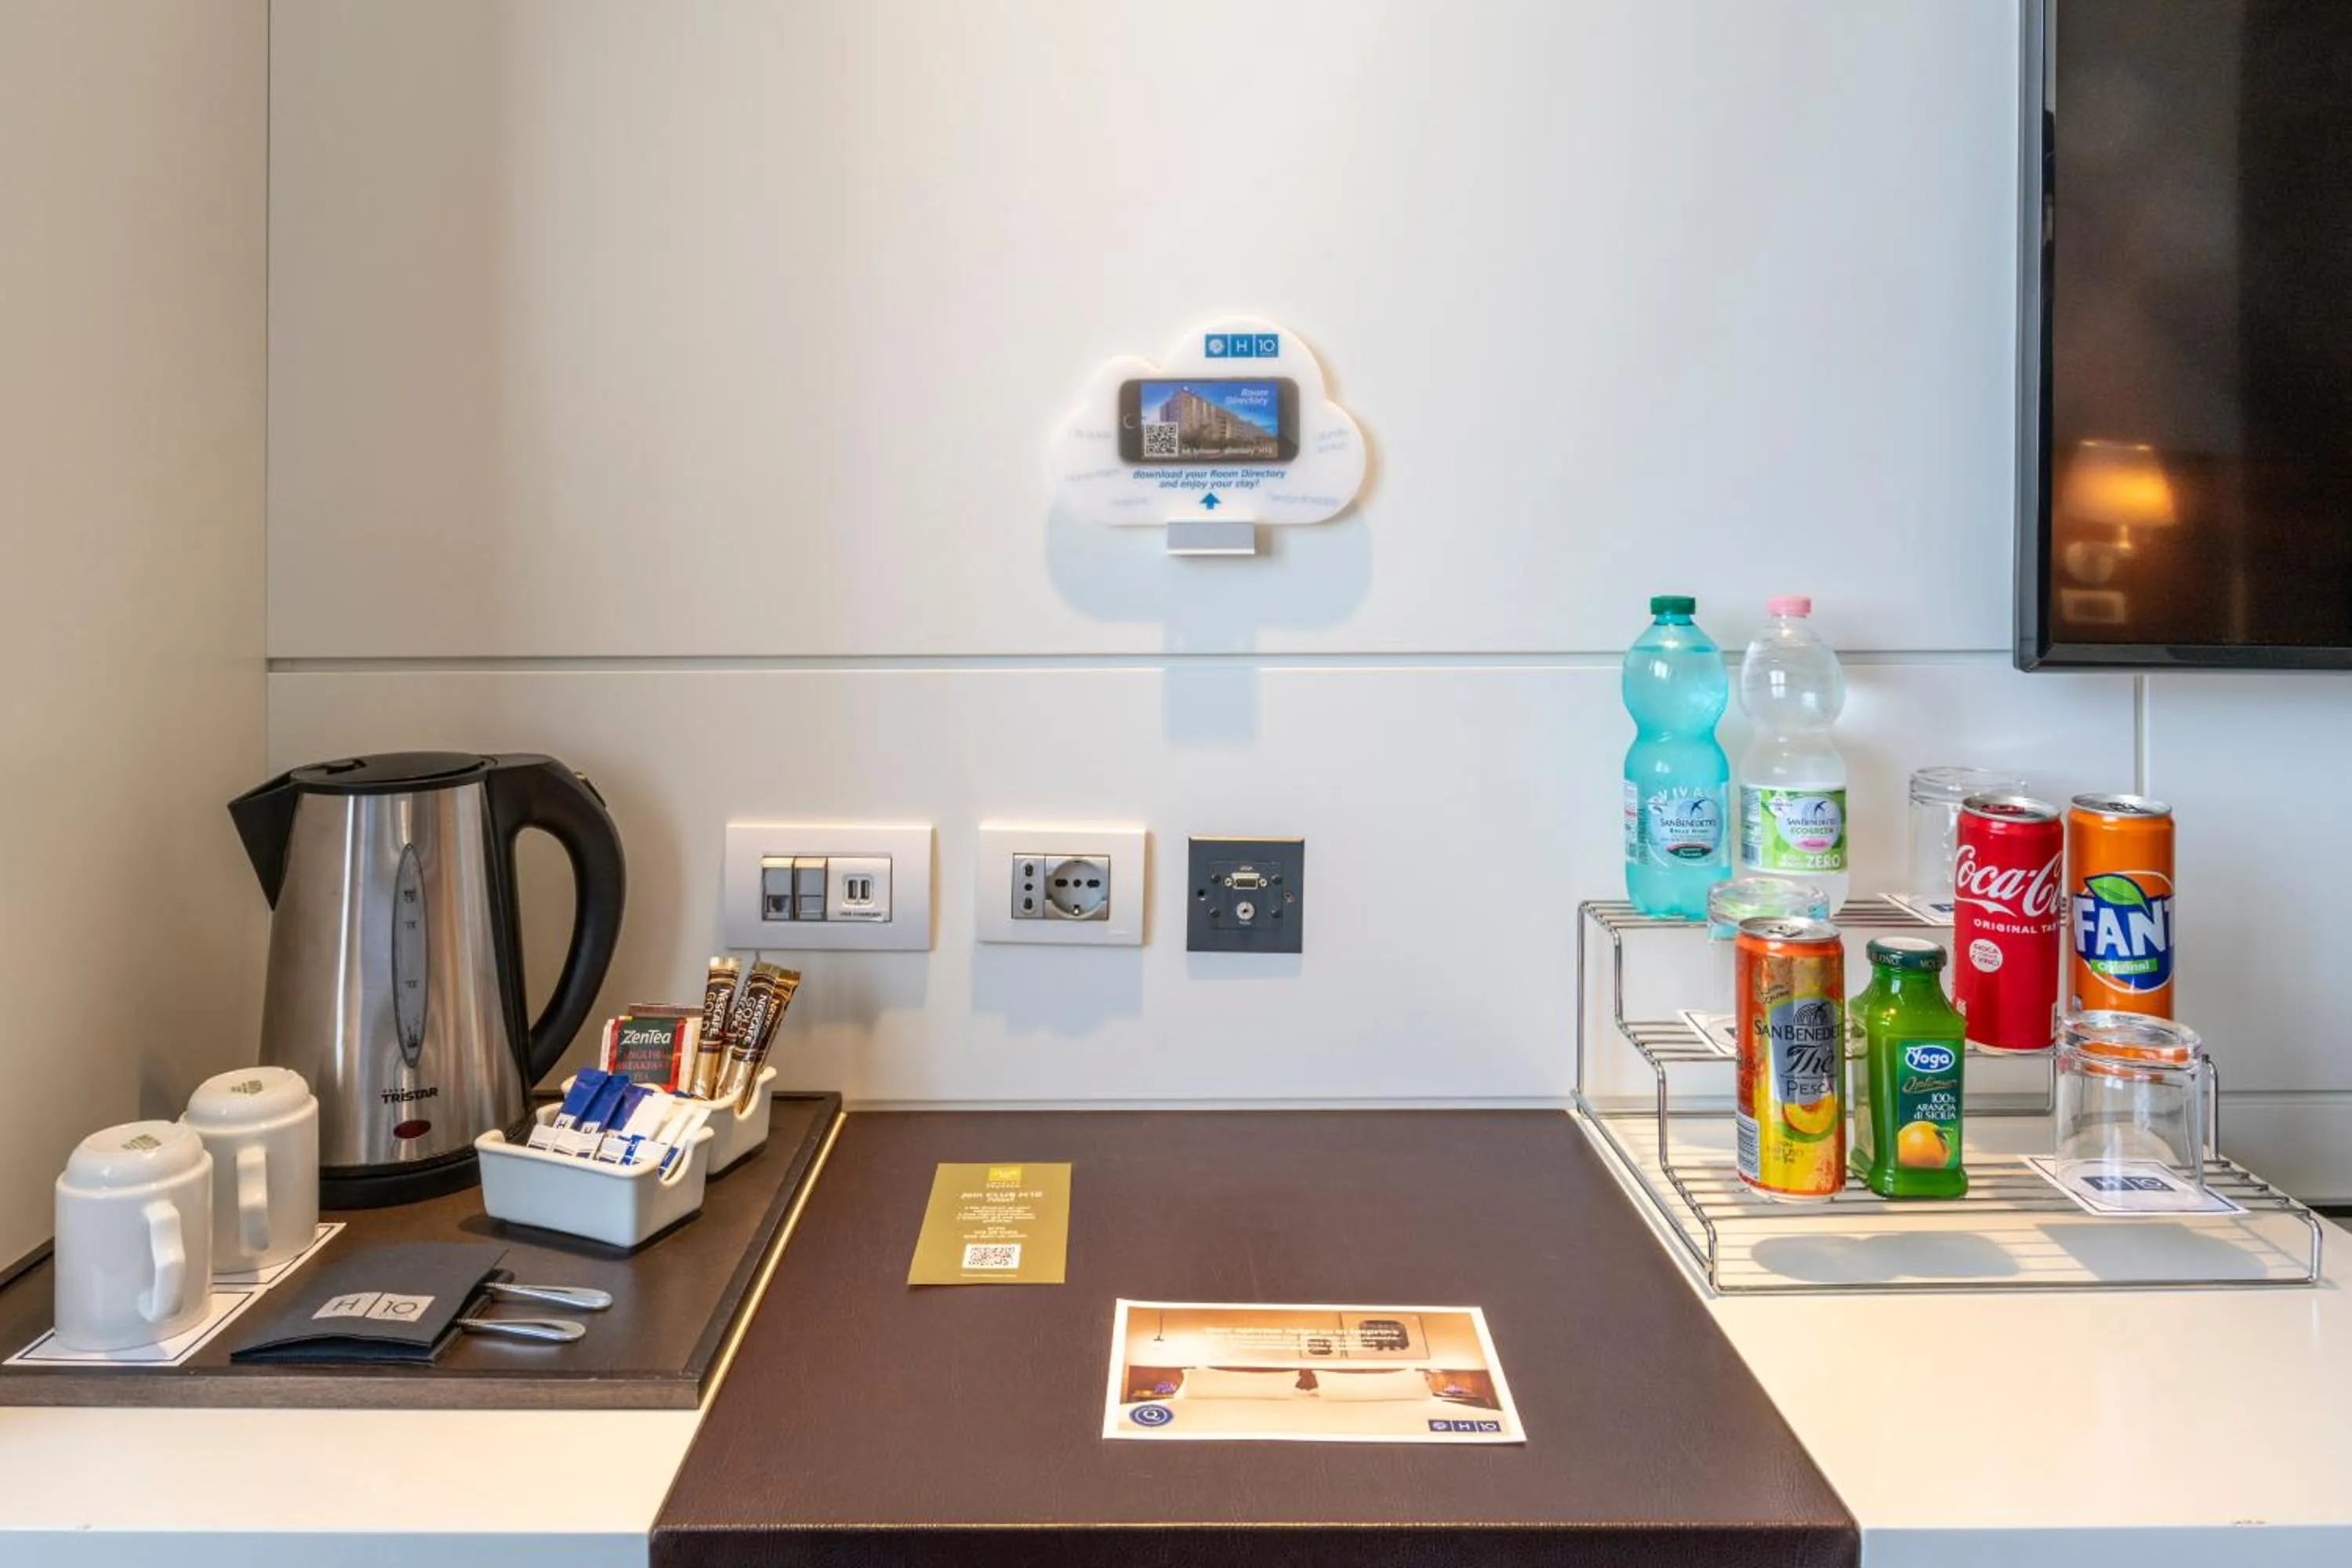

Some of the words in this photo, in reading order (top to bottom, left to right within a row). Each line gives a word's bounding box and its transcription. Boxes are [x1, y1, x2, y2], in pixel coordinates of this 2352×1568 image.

[1236, 341, 1247, 351] H
[1258, 340, 1276, 353] 10
[1133, 470, 1183, 479] download
[1185, 471, 1207, 481] your
[1210, 470, 1239, 478] Room
[1241, 469, 1287, 480] Directory
[1159, 479, 1178, 488] and
[1180, 480, 1207, 490] enjoy
[1210, 480, 1233, 490] your
[1806, 854, 1841, 869] ZERO
[1973, 917, 2038, 935] ORIGINAL
[621, 1029, 672, 1045] ZenTea
[1907, 1047, 1951, 1069] Yoga
[1915, 1103, 1957, 1112] ARANCIA
[1926, 1112, 1957, 1120] SICILIA
[332, 1298, 361, 1312] H
[383, 1300, 418, 1315] 10
